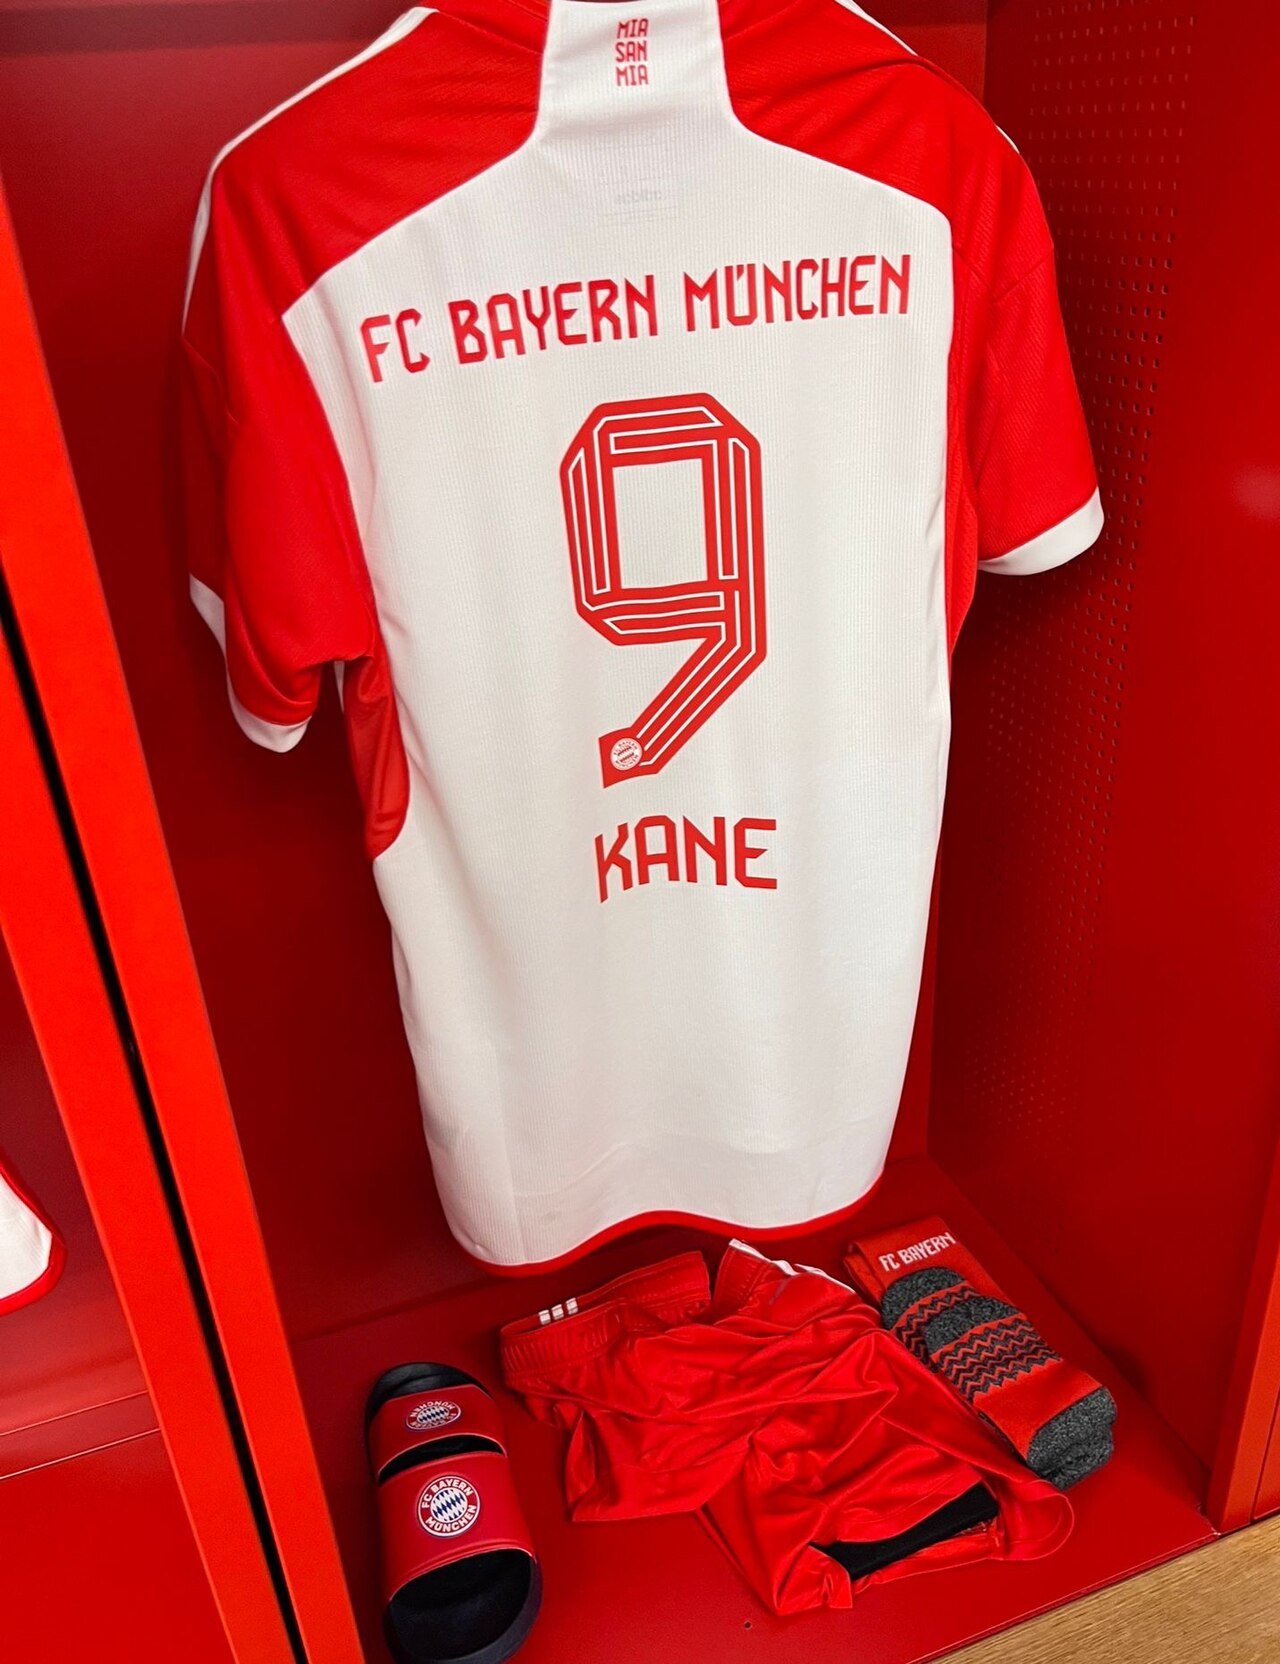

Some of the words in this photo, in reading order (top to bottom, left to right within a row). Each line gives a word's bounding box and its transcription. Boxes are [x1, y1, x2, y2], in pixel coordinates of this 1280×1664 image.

[616, 18, 649, 39] MIA
[615, 40, 648, 63] SAN
[615, 64, 649, 87] MIA
[360, 307, 431, 383] FC
[448, 274, 659, 365] BAYERN
[683, 254, 912, 333] MÜNCHEN
[560, 392, 767, 788] 9
[594, 814, 778, 905] KANE
[878, 1252, 902, 1273] FC
[897, 1231, 957, 1266] BAYERN
[421, 1493, 433, 1509] FC
[430, 1478, 474, 1496] BAYERN
